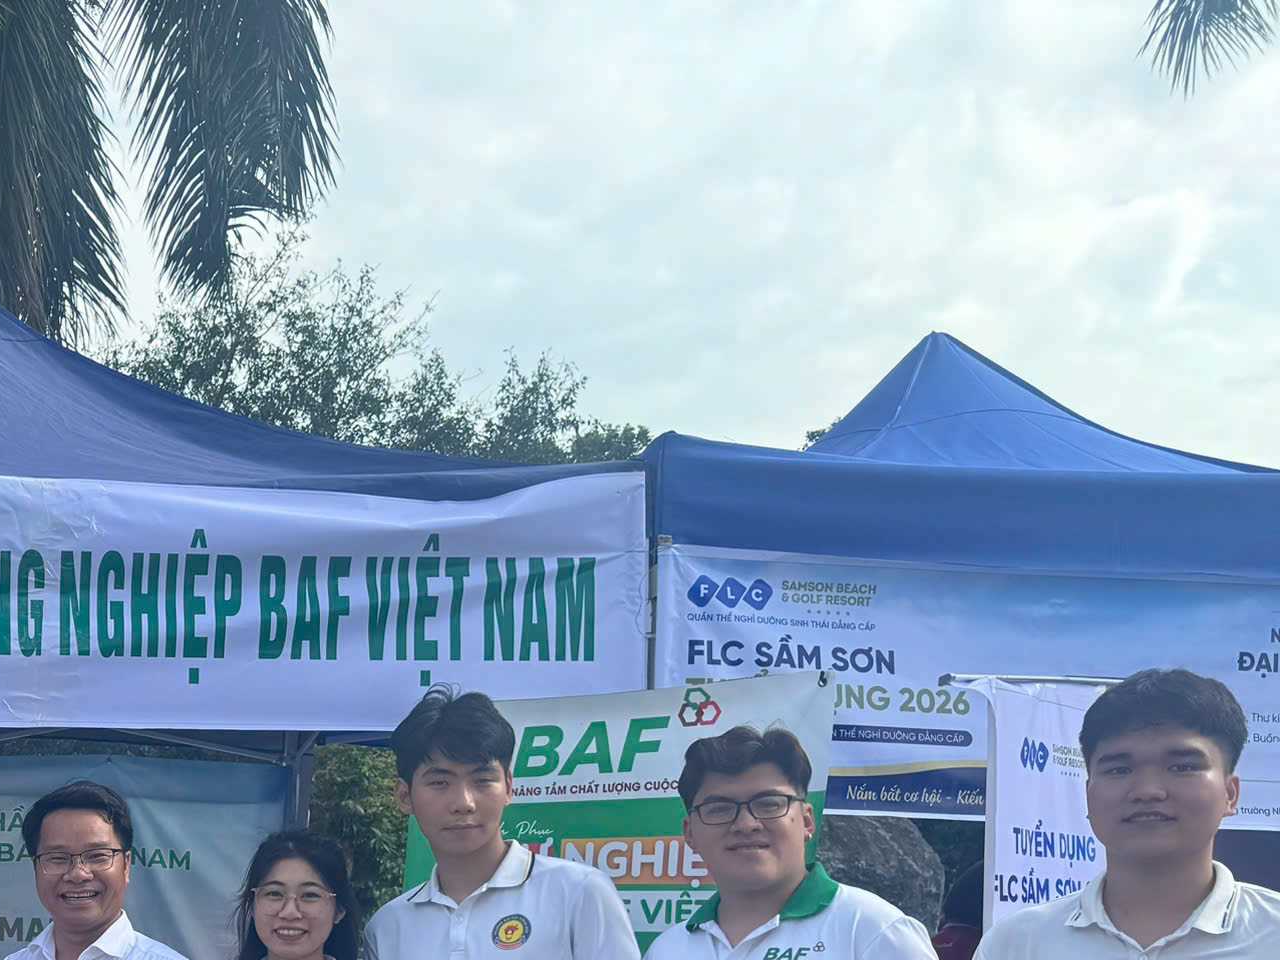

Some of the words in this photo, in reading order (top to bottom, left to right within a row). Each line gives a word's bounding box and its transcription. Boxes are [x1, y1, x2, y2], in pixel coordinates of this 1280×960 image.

[781, 580, 834, 594] SAMSON
[836, 582, 877, 595] BEACH
[60, 528, 242, 685] NGHIỆP
[258, 555, 352, 661] BAF
[366, 533, 471, 687] VIỆT
[482, 556, 596, 662] NAM
[792, 593, 824, 606] GOLF
[826, 595, 872, 607] RESORT
[790, 618, 809, 628] SINH
[687, 639, 745, 667] FLC
[754, 634, 822, 671] SẦM
[831, 646, 896, 676] SƠN
[899, 687, 971, 716] 2026
[512, 715, 672, 779] BAF
[545, 782, 567, 796] TẦM
[570, 780, 600, 795] CHẤT
[603, 779, 641, 795] LƯỢNG
[1012, 819, 1055, 859] TUYỂN
[1059, 832, 1097, 868] DỤNG
[131, 848, 191, 870] NAM
[763, 947, 811, 960] BAF
